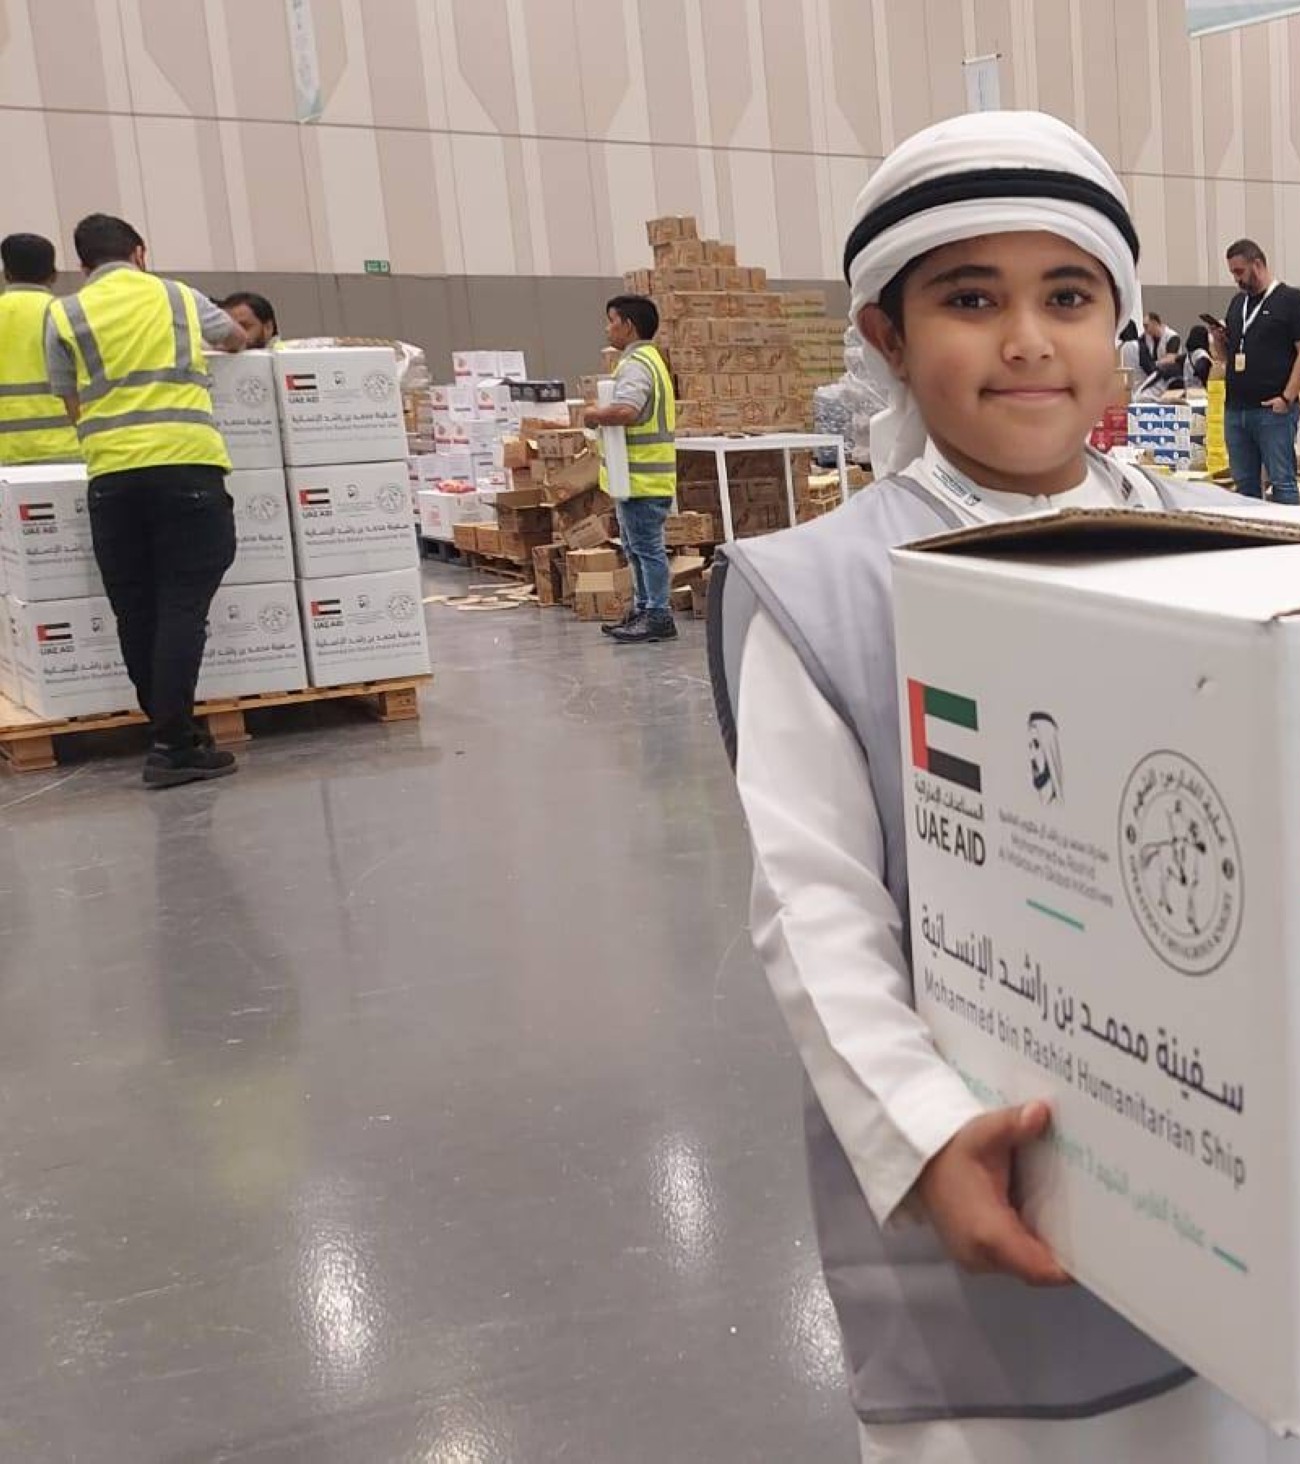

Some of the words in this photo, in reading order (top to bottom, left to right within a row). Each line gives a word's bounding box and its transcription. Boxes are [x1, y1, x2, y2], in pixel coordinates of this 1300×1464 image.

[915, 804, 951, 853] UAE
[954, 823, 986, 867] AID
[921, 905, 994, 991] الإنسانية
[998, 953, 1048, 1021] راشد
[1054, 987, 1074, 1037] بن
[1081, 1002, 1149, 1064] محمد
[924, 967, 994, 1035] Mohammed
[998, 1011, 1020, 1050] bin
[1024, 1026, 1073, 1084] Rashid
[1077, 1057, 1196, 1156] Humanitarian
[1201, 1129, 1246, 1190] Ship
[1156, 1026, 1244, 1115] سفينة
